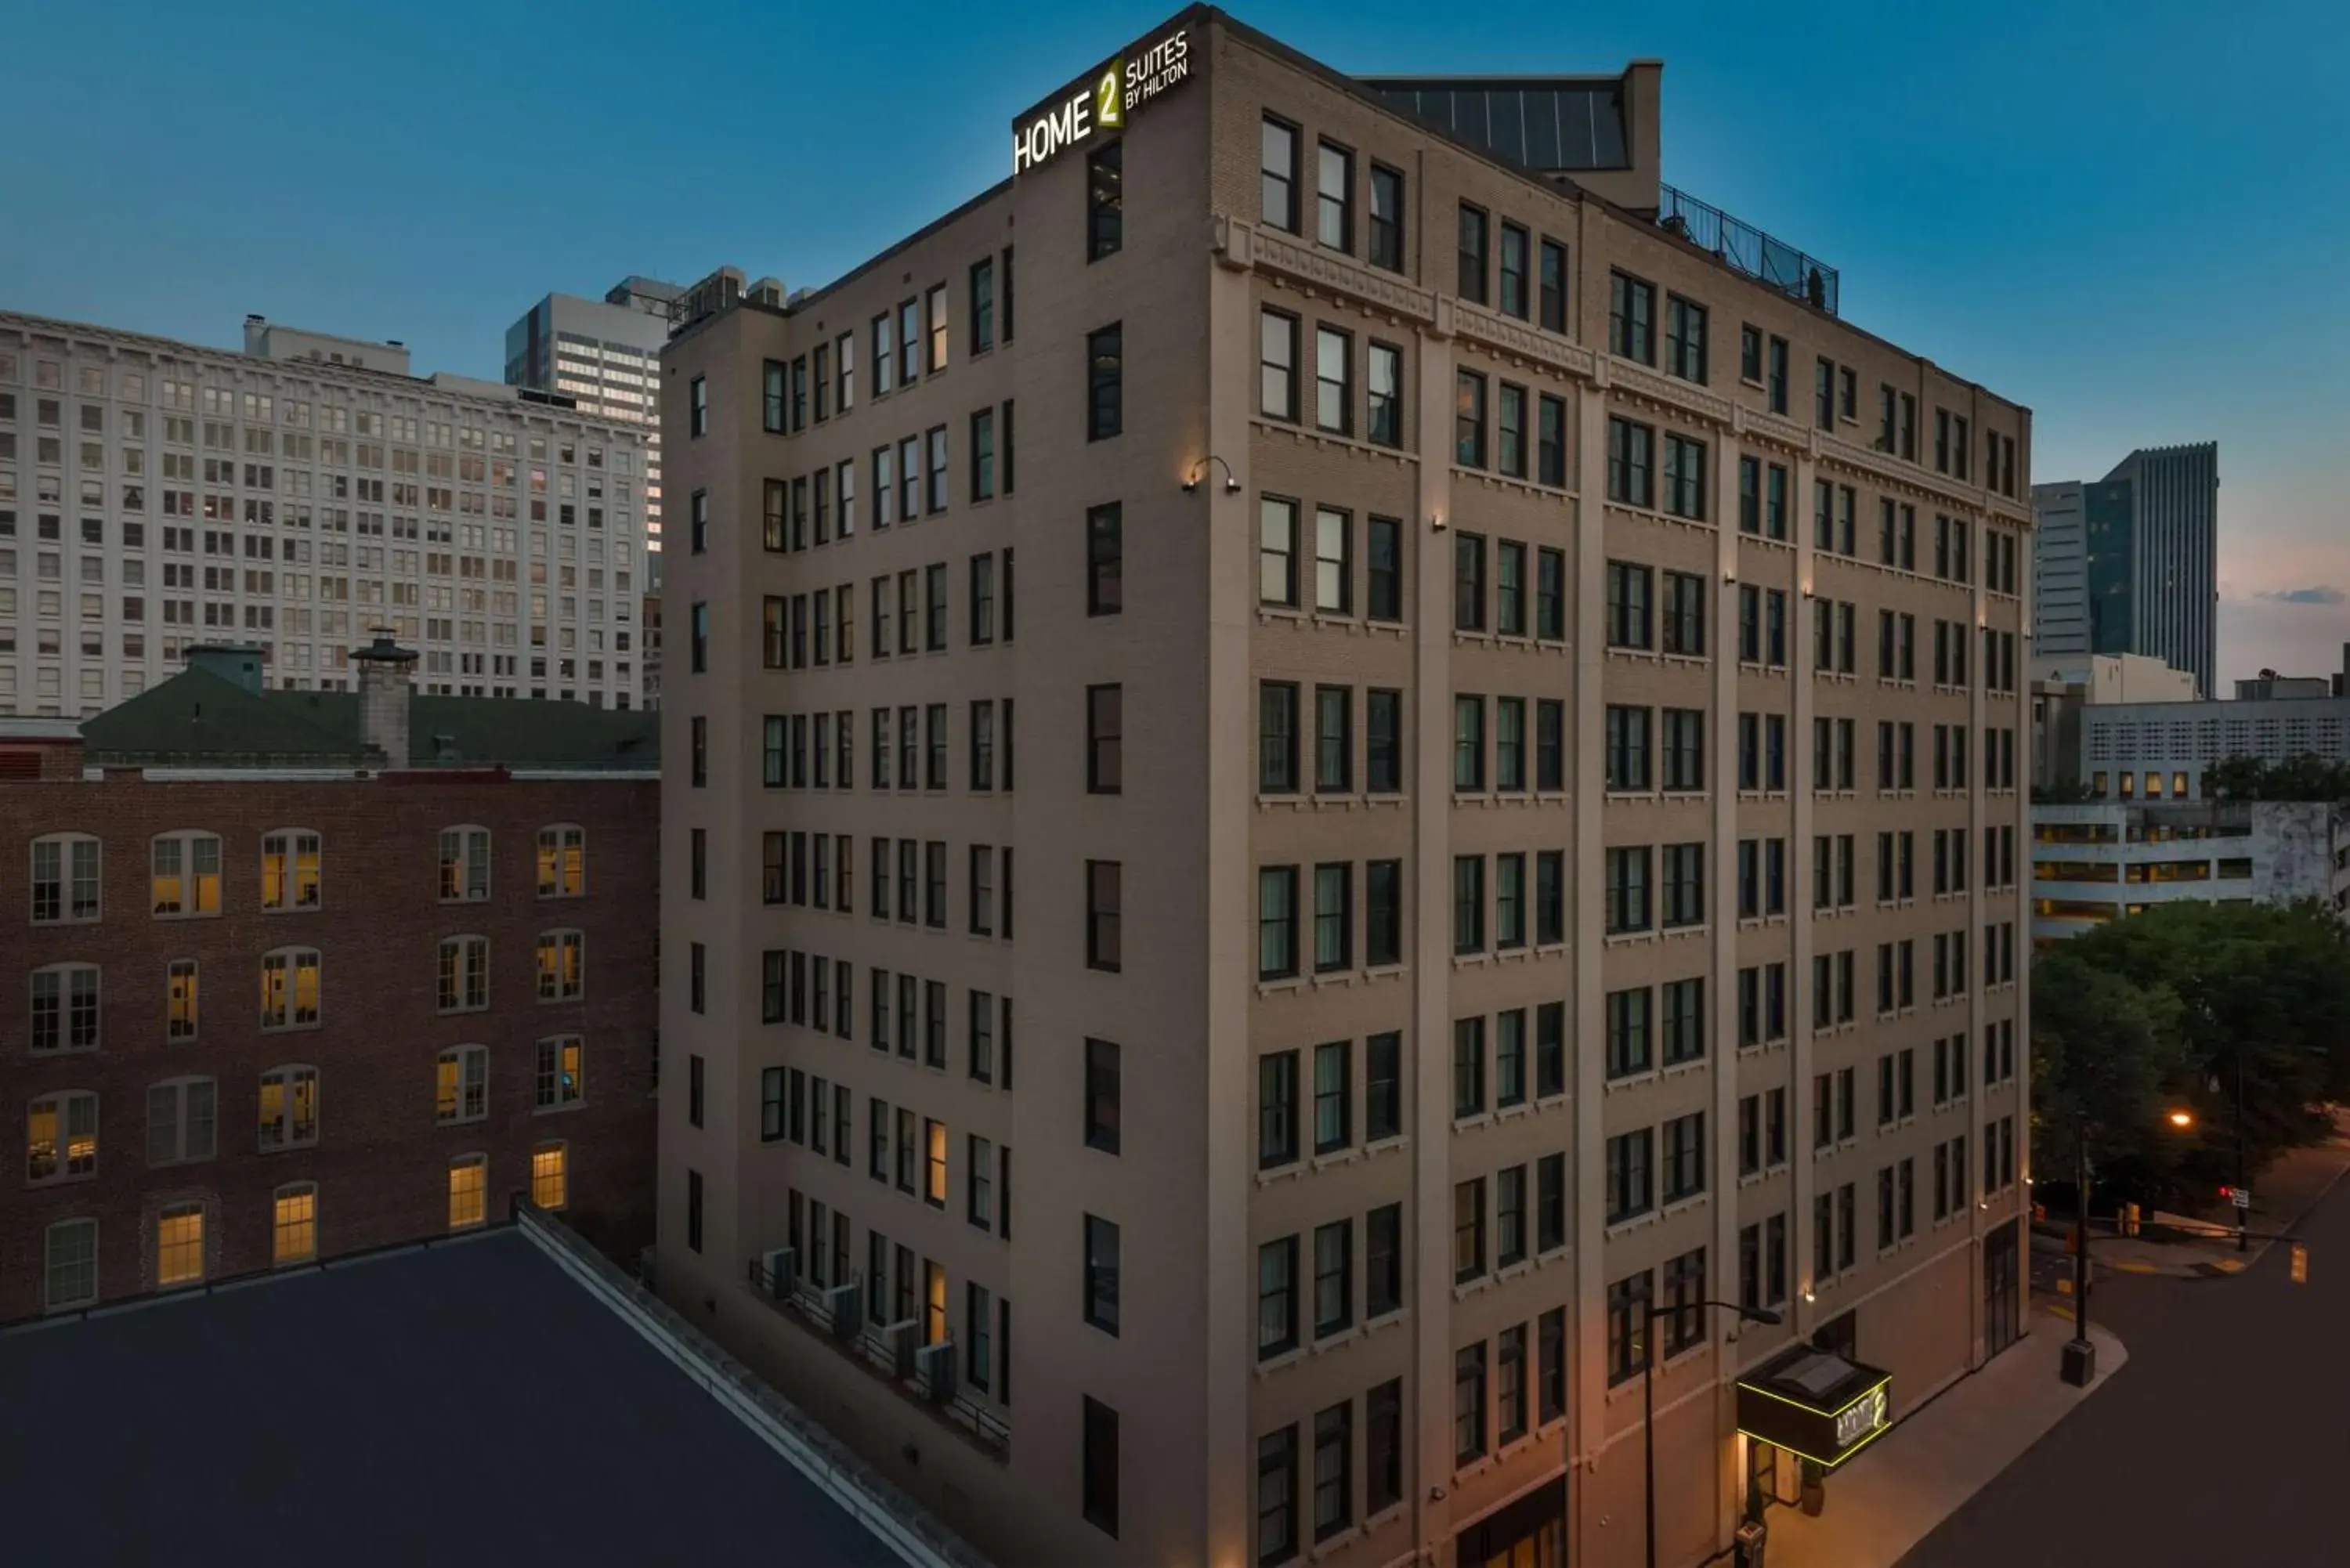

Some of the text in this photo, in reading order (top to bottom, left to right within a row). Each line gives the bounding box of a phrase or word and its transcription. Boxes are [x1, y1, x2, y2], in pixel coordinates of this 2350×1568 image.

[1126, 31, 1187, 89] SUITES
[1126, 58, 1187, 110] BY HILTON
[1014, 71, 1117, 175] HOME 2
